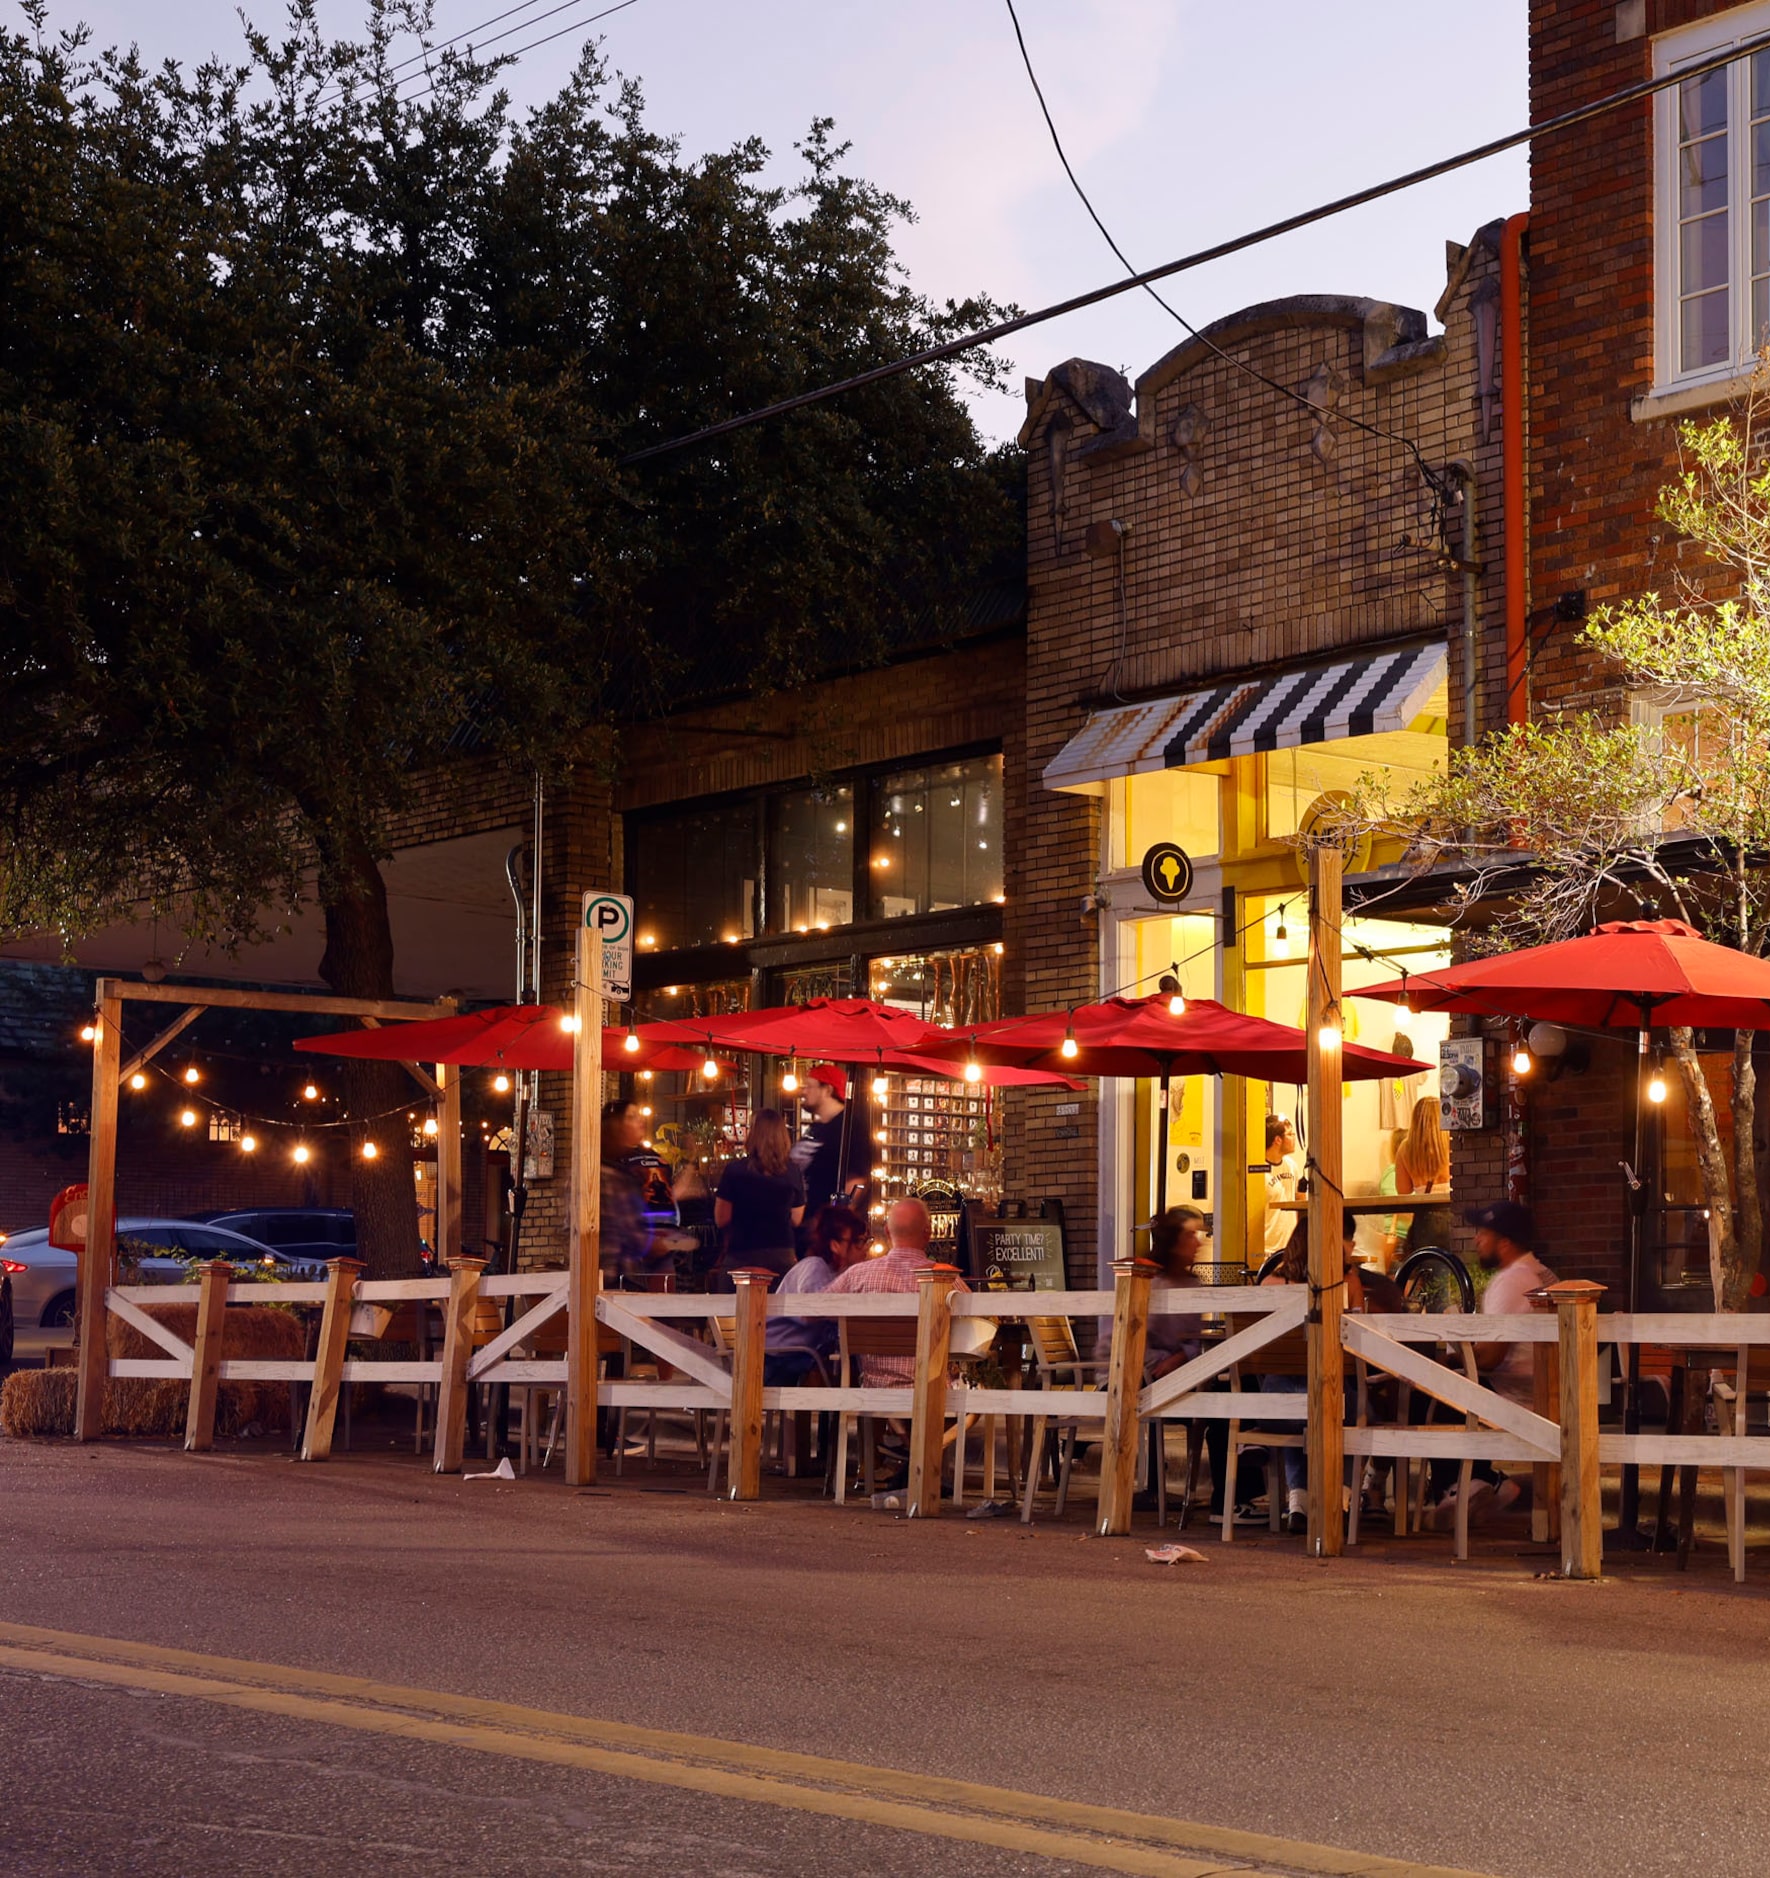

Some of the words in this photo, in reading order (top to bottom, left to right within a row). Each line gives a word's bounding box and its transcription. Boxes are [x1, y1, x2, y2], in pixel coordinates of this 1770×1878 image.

[598, 906, 619, 928] P
[603, 969, 616, 979] MIT
[64, 1184, 89, 1203] Eno
[994, 1232, 1021, 1246] PARTY
[1024, 1232, 1044, 1246] TIME?
[995, 1247, 1045, 1262] EXCELLENT!
